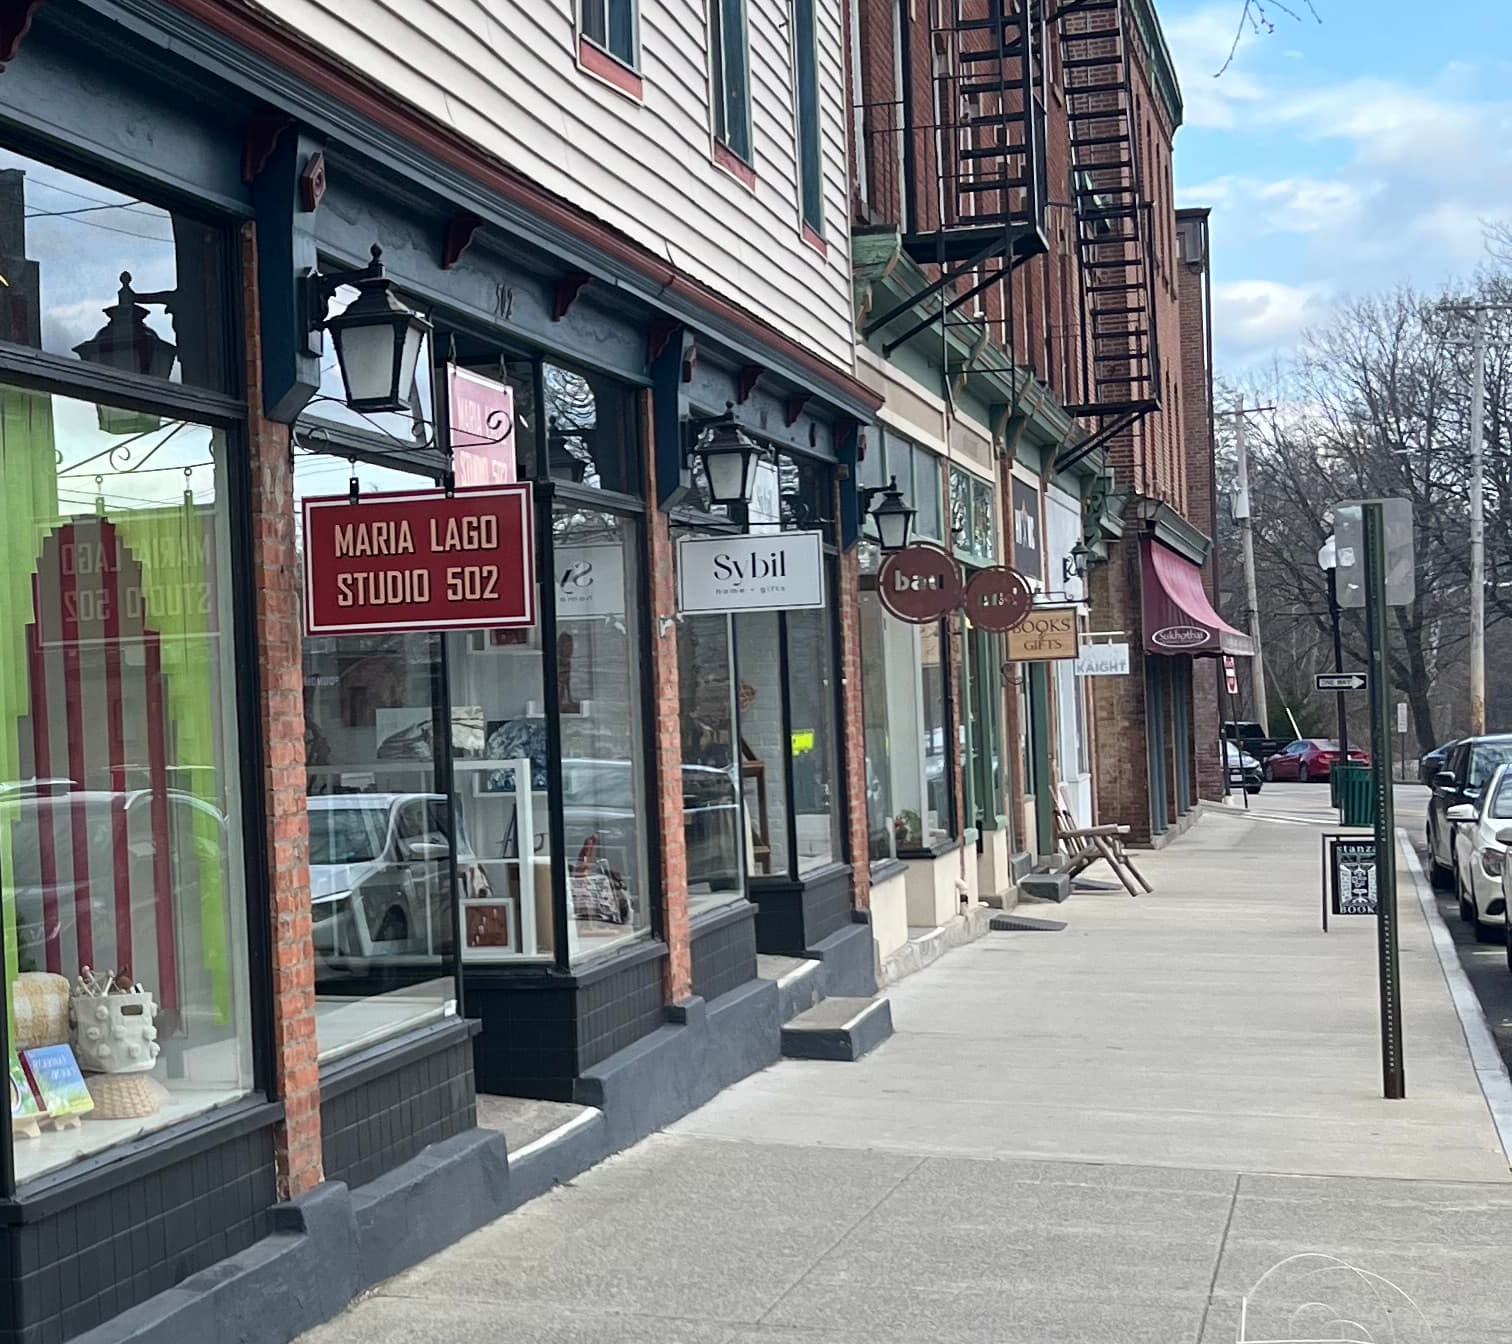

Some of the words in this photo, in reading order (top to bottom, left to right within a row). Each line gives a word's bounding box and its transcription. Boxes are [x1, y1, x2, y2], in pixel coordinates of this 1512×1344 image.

[334, 519, 415, 558] MARIA
[429, 514, 498, 553] LAGO
[713, 549, 786, 587] Sybil
[336, 568, 430, 607] STUDIO
[445, 564, 499, 602] 502
[1023, 638, 1063, 651] GIFTS
[1076, 661, 1127, 673] KAIGHT
[1340, 905, 1377, 914] BOOK
